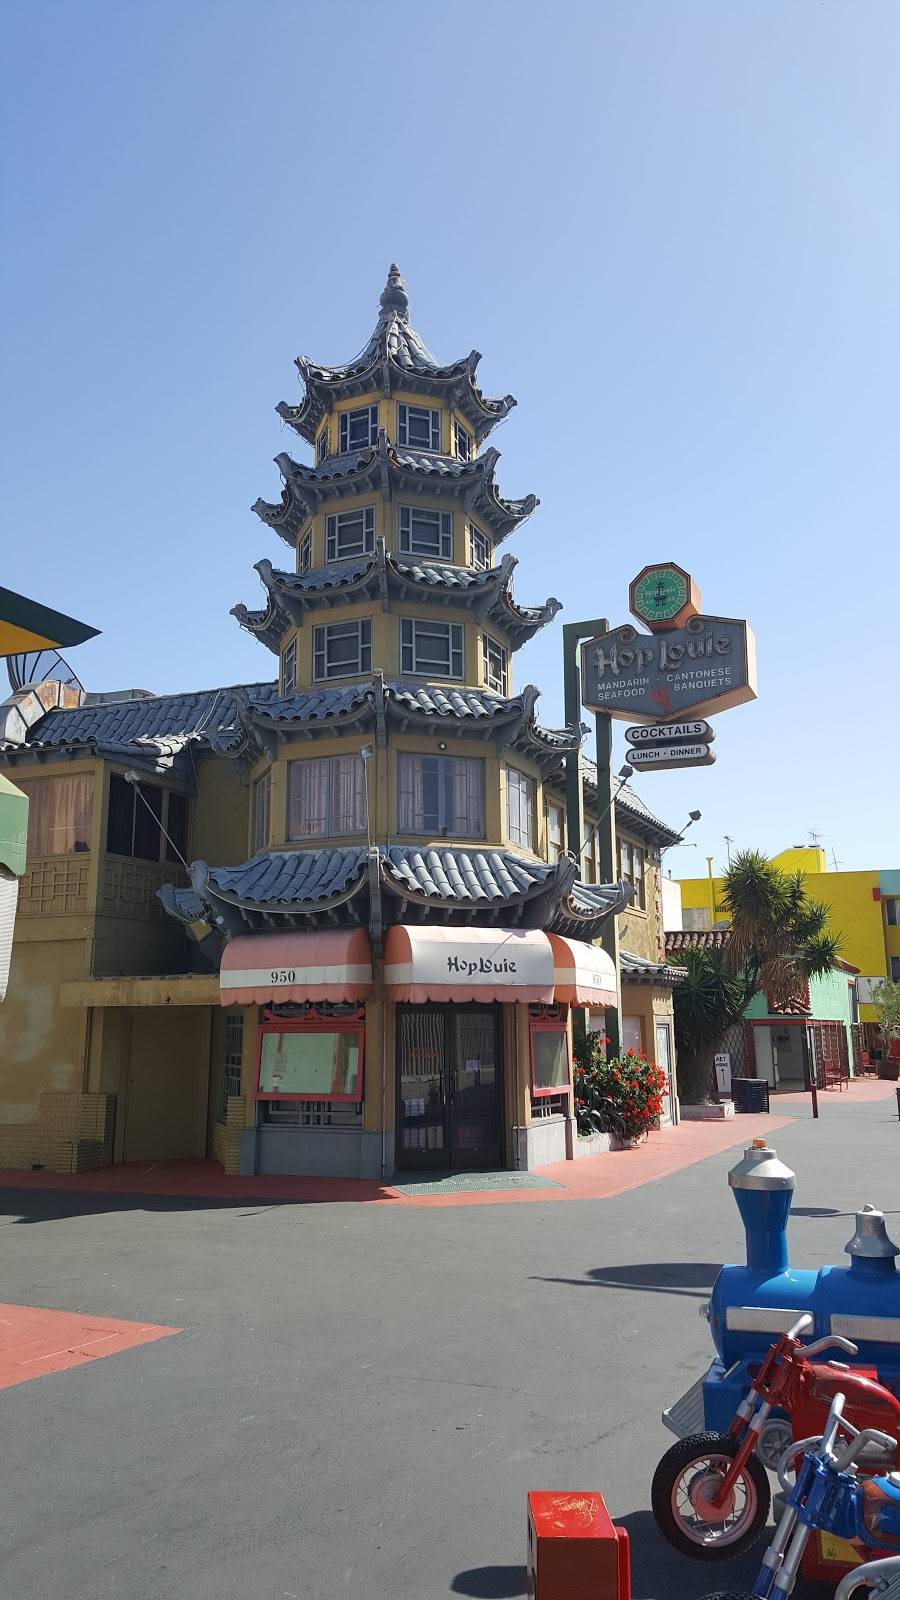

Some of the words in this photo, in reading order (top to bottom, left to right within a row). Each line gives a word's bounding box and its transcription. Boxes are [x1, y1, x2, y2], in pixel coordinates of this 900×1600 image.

[593, 644, 653, 677] Hop
[658, 632, 731, 670] Louie
[597, 677, 649, 691] MANDARIN
[666, 667, 731, 682] CANTONESE
[598, 687, 645, 700] SEAFOOD
[674, 677, 731, 691] BANQUETS
[631, 723, 701, 739] COCKTAILS
[632, 751, 660, 760] LUNCH
[670, 747, 701, 757] DINNER
[271, 970, 296, 984] 950
